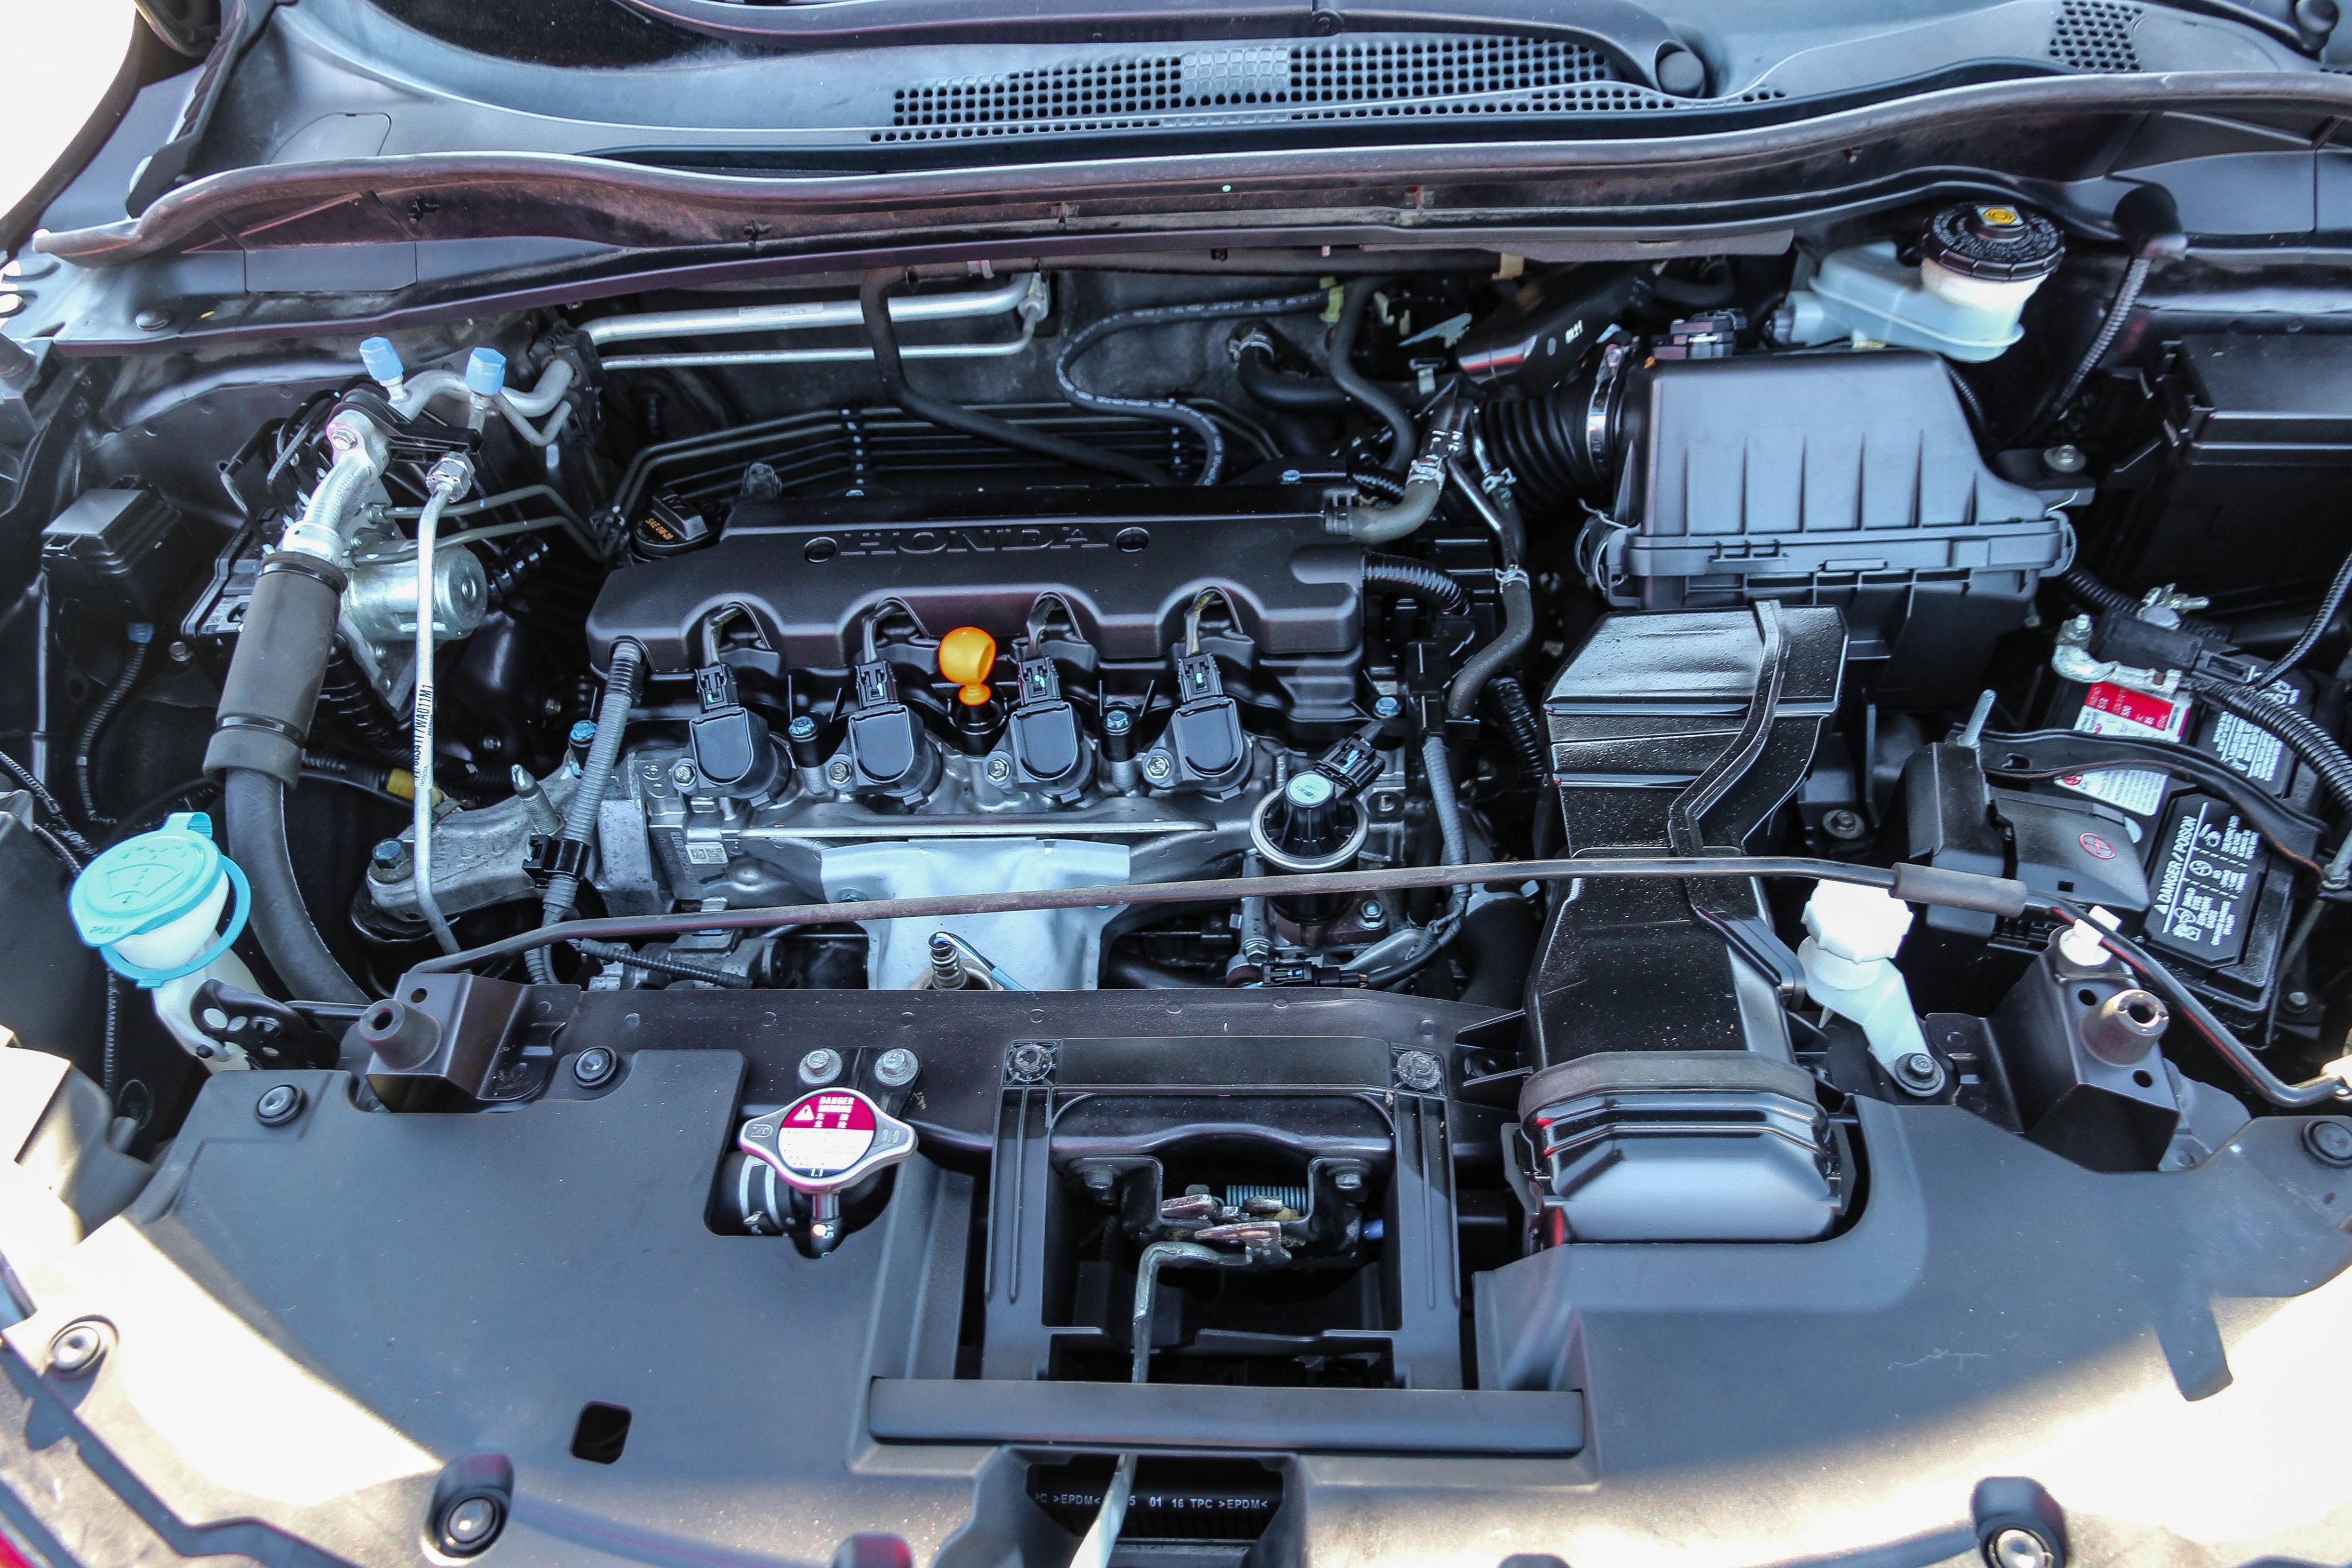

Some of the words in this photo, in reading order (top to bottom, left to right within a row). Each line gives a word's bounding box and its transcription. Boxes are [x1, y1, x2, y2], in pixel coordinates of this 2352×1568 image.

[840, 526, 1109, 555] HONDA
[818, 1096, 855, 1105] DANGER
[1149, 1496, 1162, 1507] 01
[1172, 1498, 1184, 1508] 16
[1190, 1499, 1213, 1509] TPC
